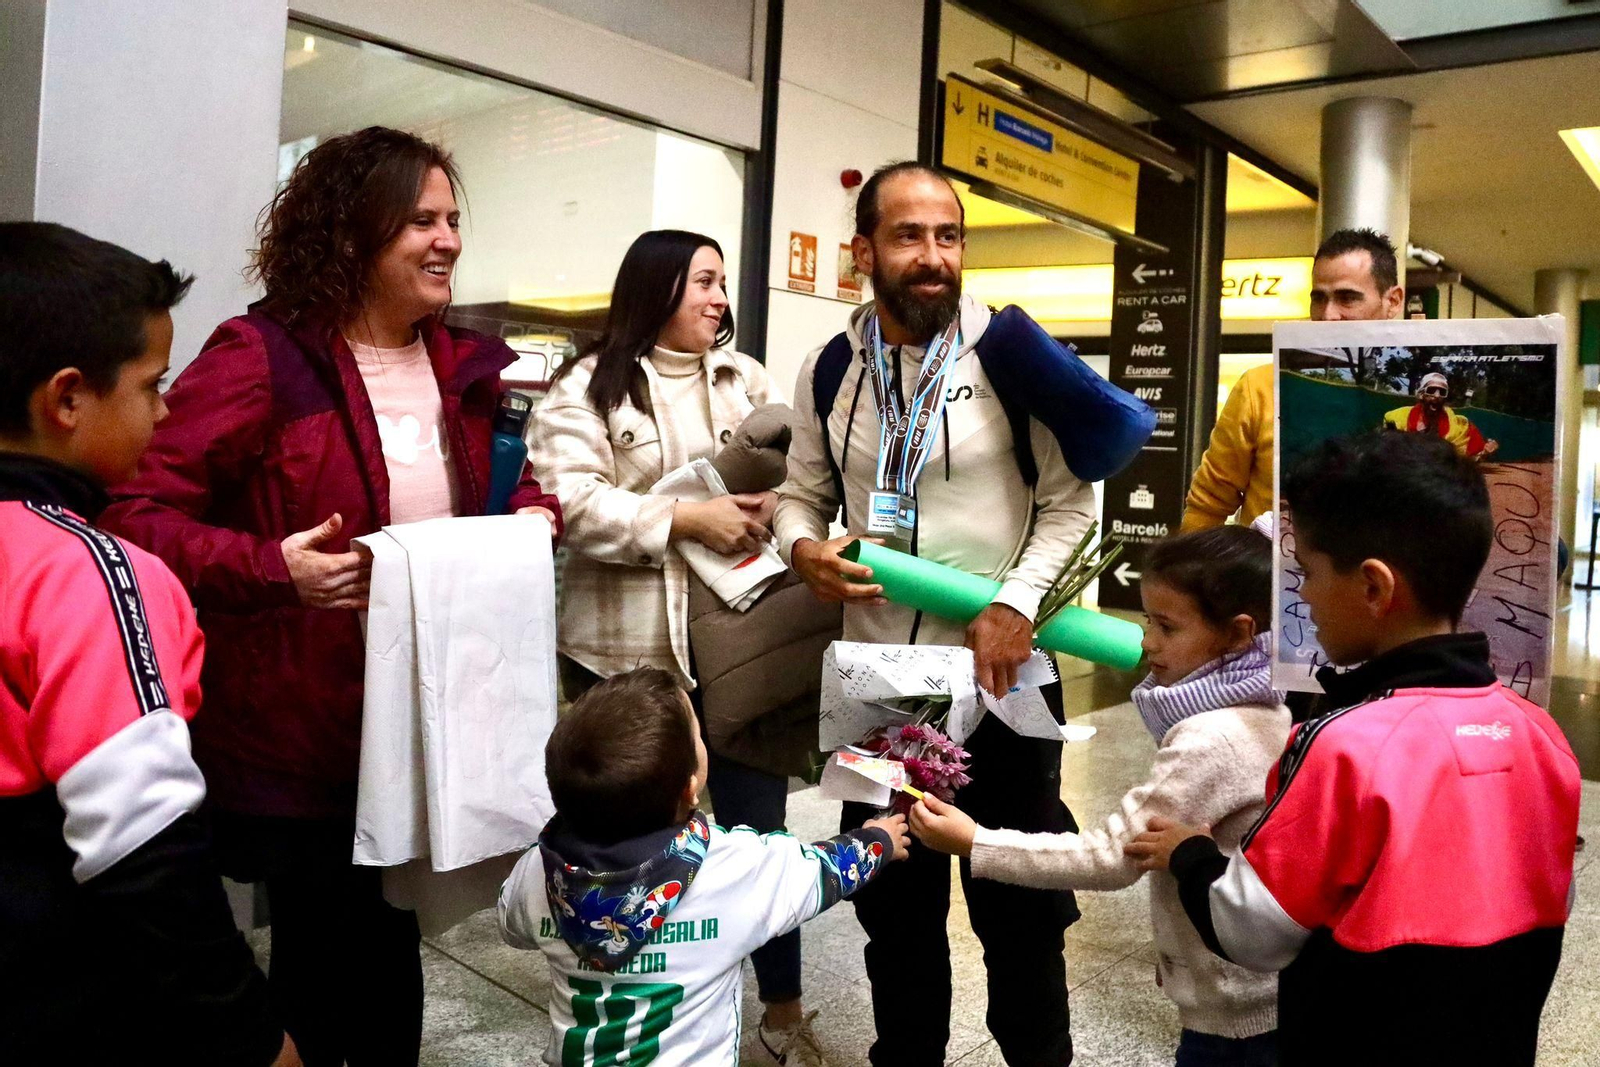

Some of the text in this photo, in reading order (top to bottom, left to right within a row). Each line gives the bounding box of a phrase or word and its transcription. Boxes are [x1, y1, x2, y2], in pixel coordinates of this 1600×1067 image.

[977, 102, 989, 127] H
[1027, 163, 1038, 178] de
[1221, 273, 1281, 297] ertz
[1117, 295, 1187, 306] RENT A CAR
[1131, 344, 1166, 357] Hertz
[1125, 365, 1172, 377] Europcar
[1134, 387, 1162, 400] AVIS
[1155, 410, 1175, 419] rise
[1112, 520, 1169, 536] Barceló
[644, 918, 719, 945] OSALIA
[562, 976, 684, 1067] 10
